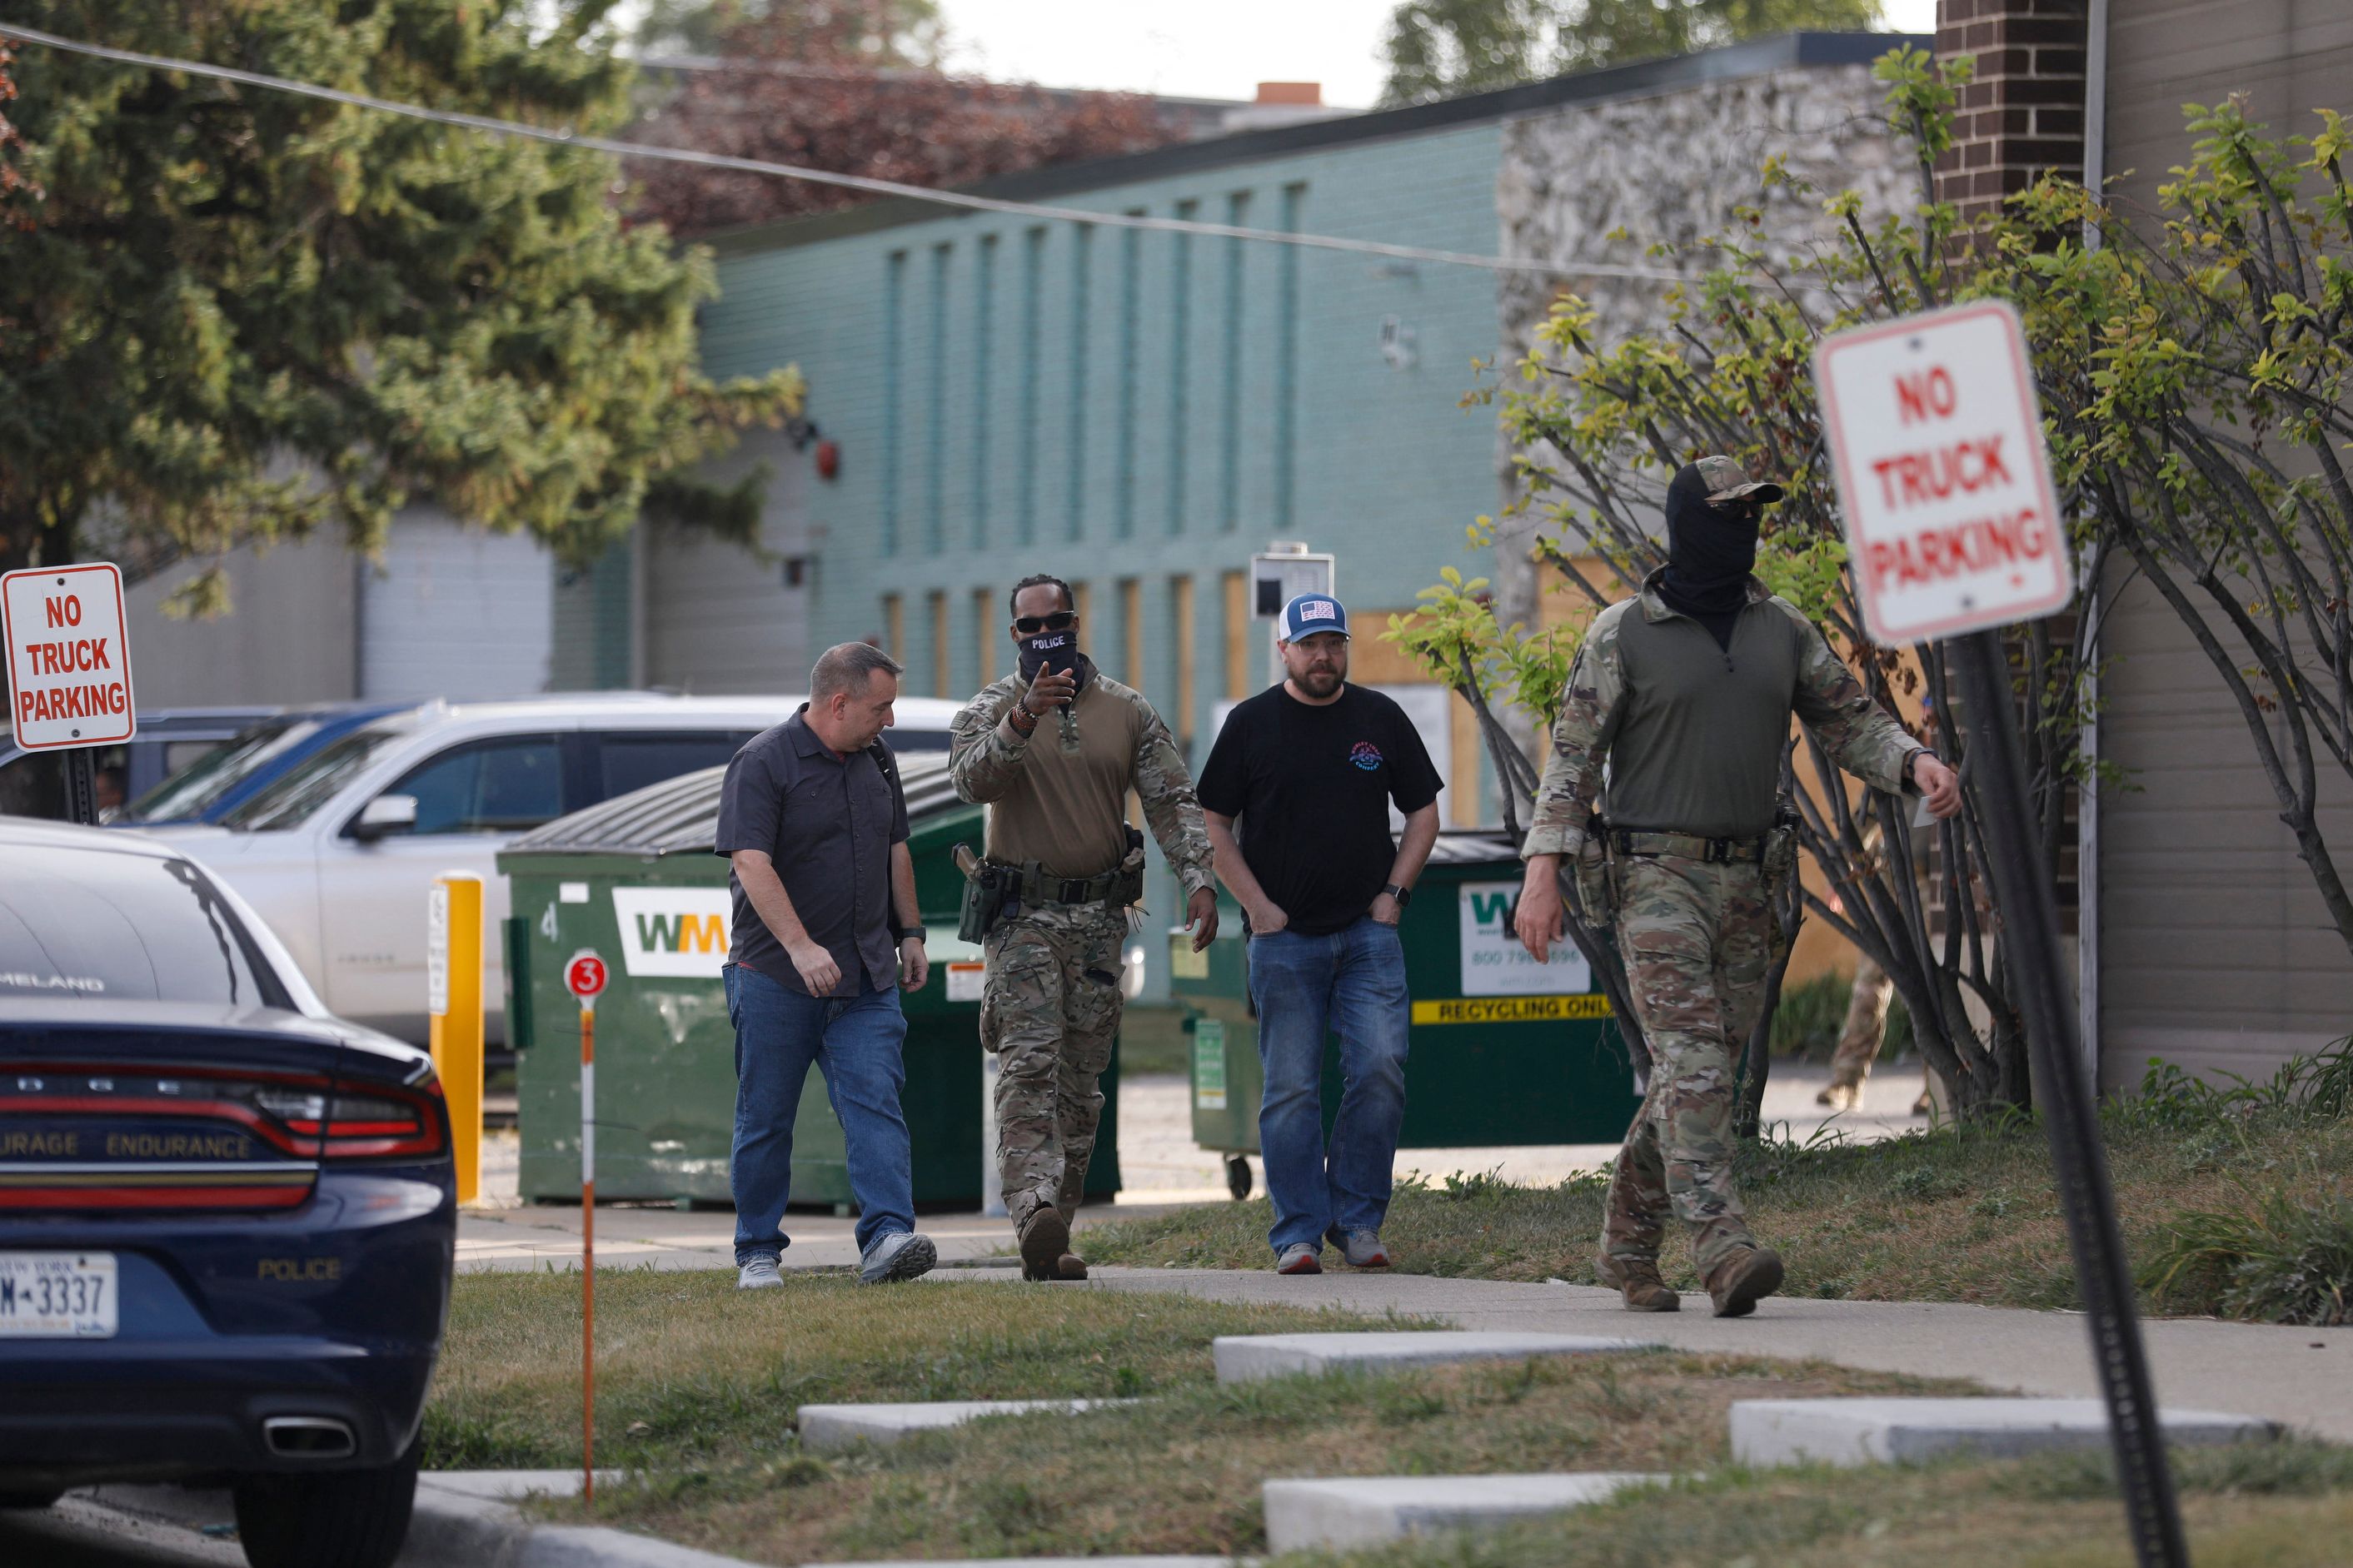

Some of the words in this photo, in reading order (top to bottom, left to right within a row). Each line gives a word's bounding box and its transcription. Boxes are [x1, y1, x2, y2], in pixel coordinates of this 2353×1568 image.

[1892, 366, 1957, 425] NO
[1871, 434, 2013, 513] TRUCK
[1868, 508, 2046, 593] PARKING
[45, 595, 82, 629] NO
[26, 638, 111, 676] TRUCK
[1032, 635, 1065, 650] POLICE
[19, 682, 125, 723] PARKING
[635, 913, 729, 954] WM
[576, 960, 598, 991] 3
[1438, 1002, 1560, 1021] RECYCLING
[1567, 998, 1610, 1017] ONL
[106, 1133, 250, 1159] ENDURANCE
[258, 1258, 341, 1281] POLICE
